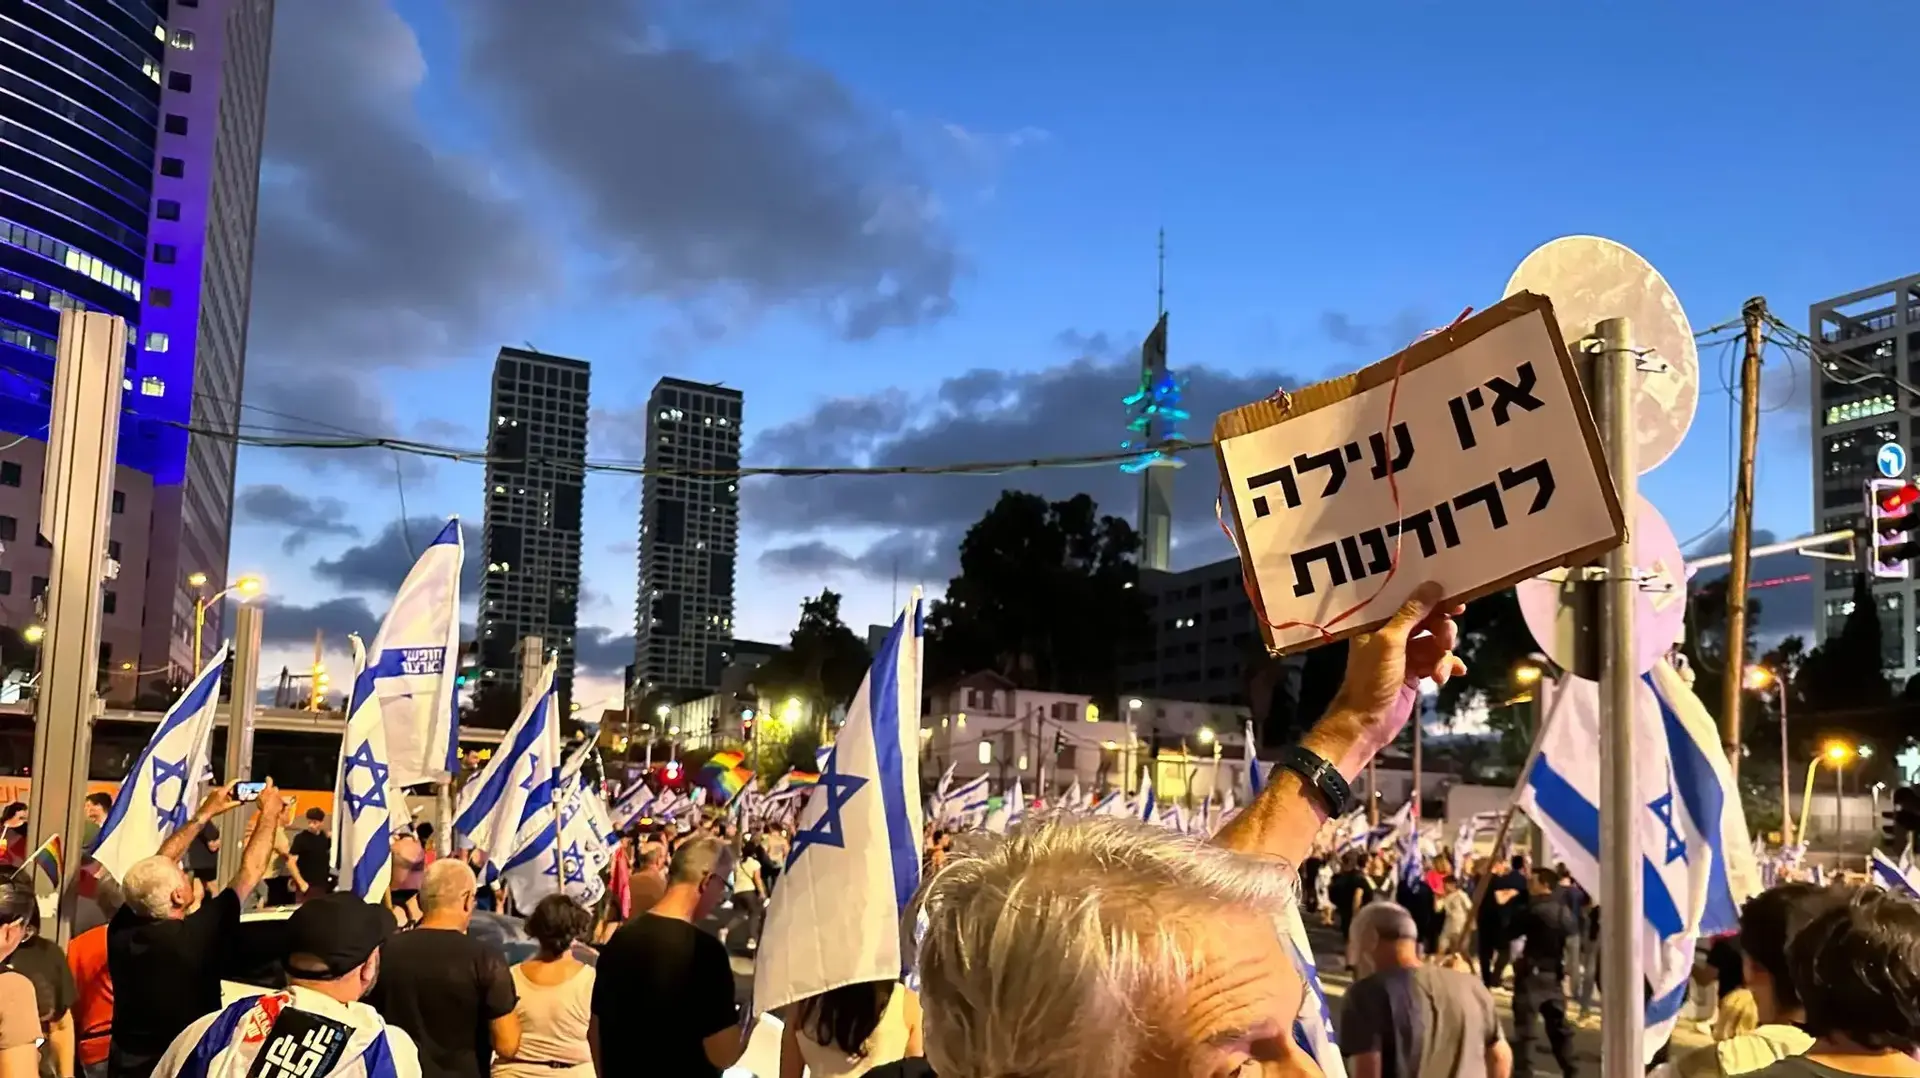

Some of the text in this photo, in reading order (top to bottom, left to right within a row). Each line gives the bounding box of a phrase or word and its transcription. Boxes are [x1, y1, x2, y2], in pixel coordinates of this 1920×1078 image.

[1246, 361, 1546, 518] אין עילה
[1290, 458, 1556, 598] לרודנות
